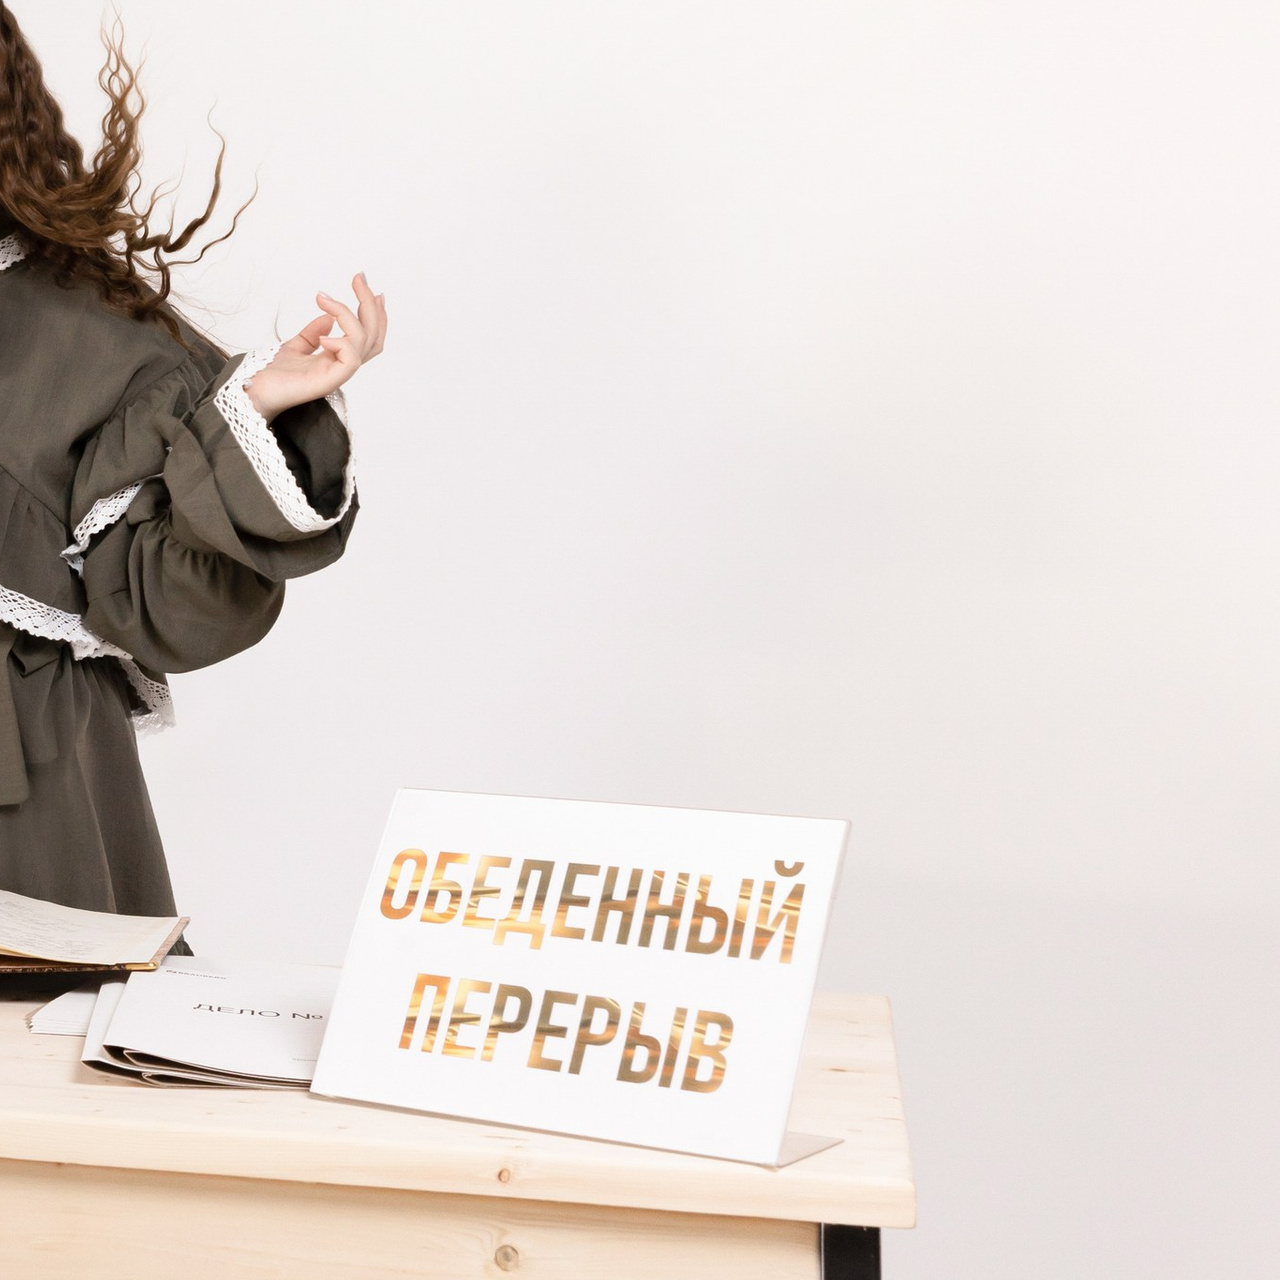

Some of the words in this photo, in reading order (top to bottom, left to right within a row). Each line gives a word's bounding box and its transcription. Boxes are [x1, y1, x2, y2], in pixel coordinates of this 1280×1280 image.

[379, 847, 806, 965] ОБЕДЕННЫЙ
[192, 1003, 281, 1018] ДЕЛО
[291, 1012, 324, 1020] №
[397, 972, 735, 1094] ПЕРЕРЫВ
